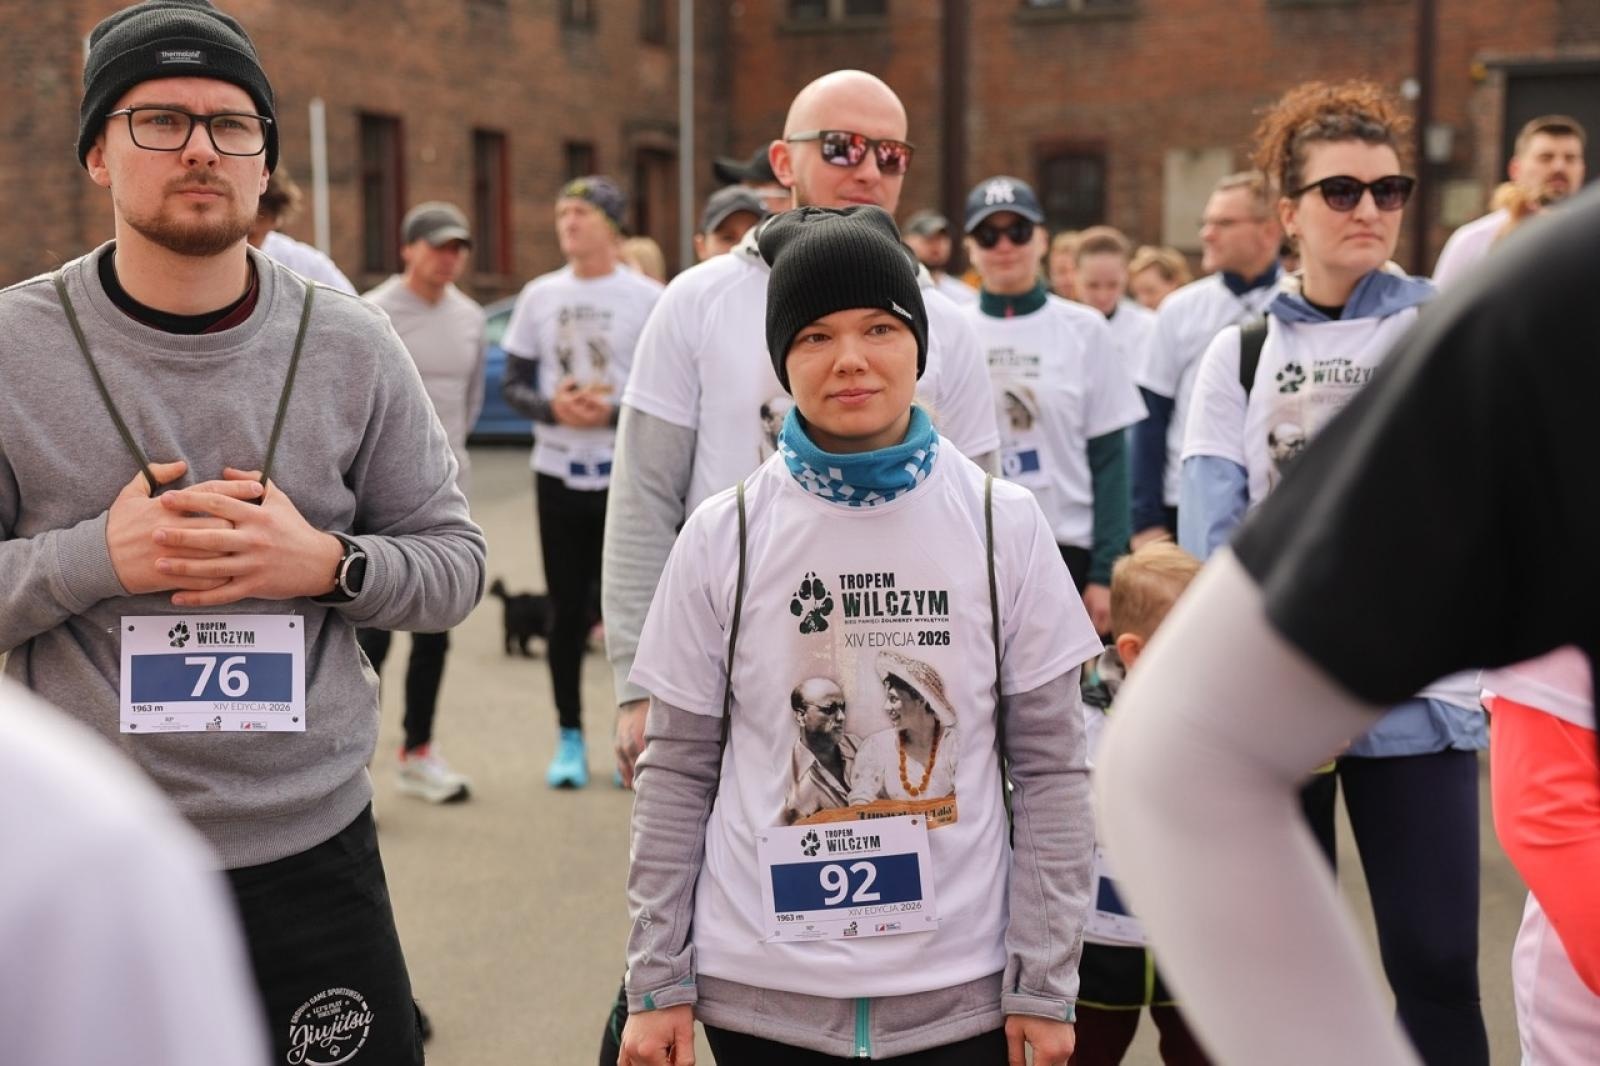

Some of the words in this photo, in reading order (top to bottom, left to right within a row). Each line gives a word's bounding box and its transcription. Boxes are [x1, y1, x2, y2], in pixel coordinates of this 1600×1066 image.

[839, 572, 895, 590] TROPEM
[841, 590, 949, 617] WILCZYM
[196, 622, 227, 631] TROPEM
[196, 631, 255, 645] WILCZYM
[845, 632, 865, 647] XIV
[868, 631, 916, 646] EDYCJA
[917, 630, 950, 646] 2026
[185, 655, 250, 697] 76
[132, 704, 152, 713] 1963
[213, 703, 230, 711] XIV
[231, 703, 267, 711] EDYCJA
[269, 703, 291, 712] 2026
[825, 828, 853, 838] TROPEM
[826, 835, 881, 853] WILCZYM
[819, 861, 881, 906] 92
[776, 914, 795, 922] 1963
[848, 908, 863, 917] XIV
[864, 904, 899, 916] EDYCJA
[900, 902, 922, 911] 2026
